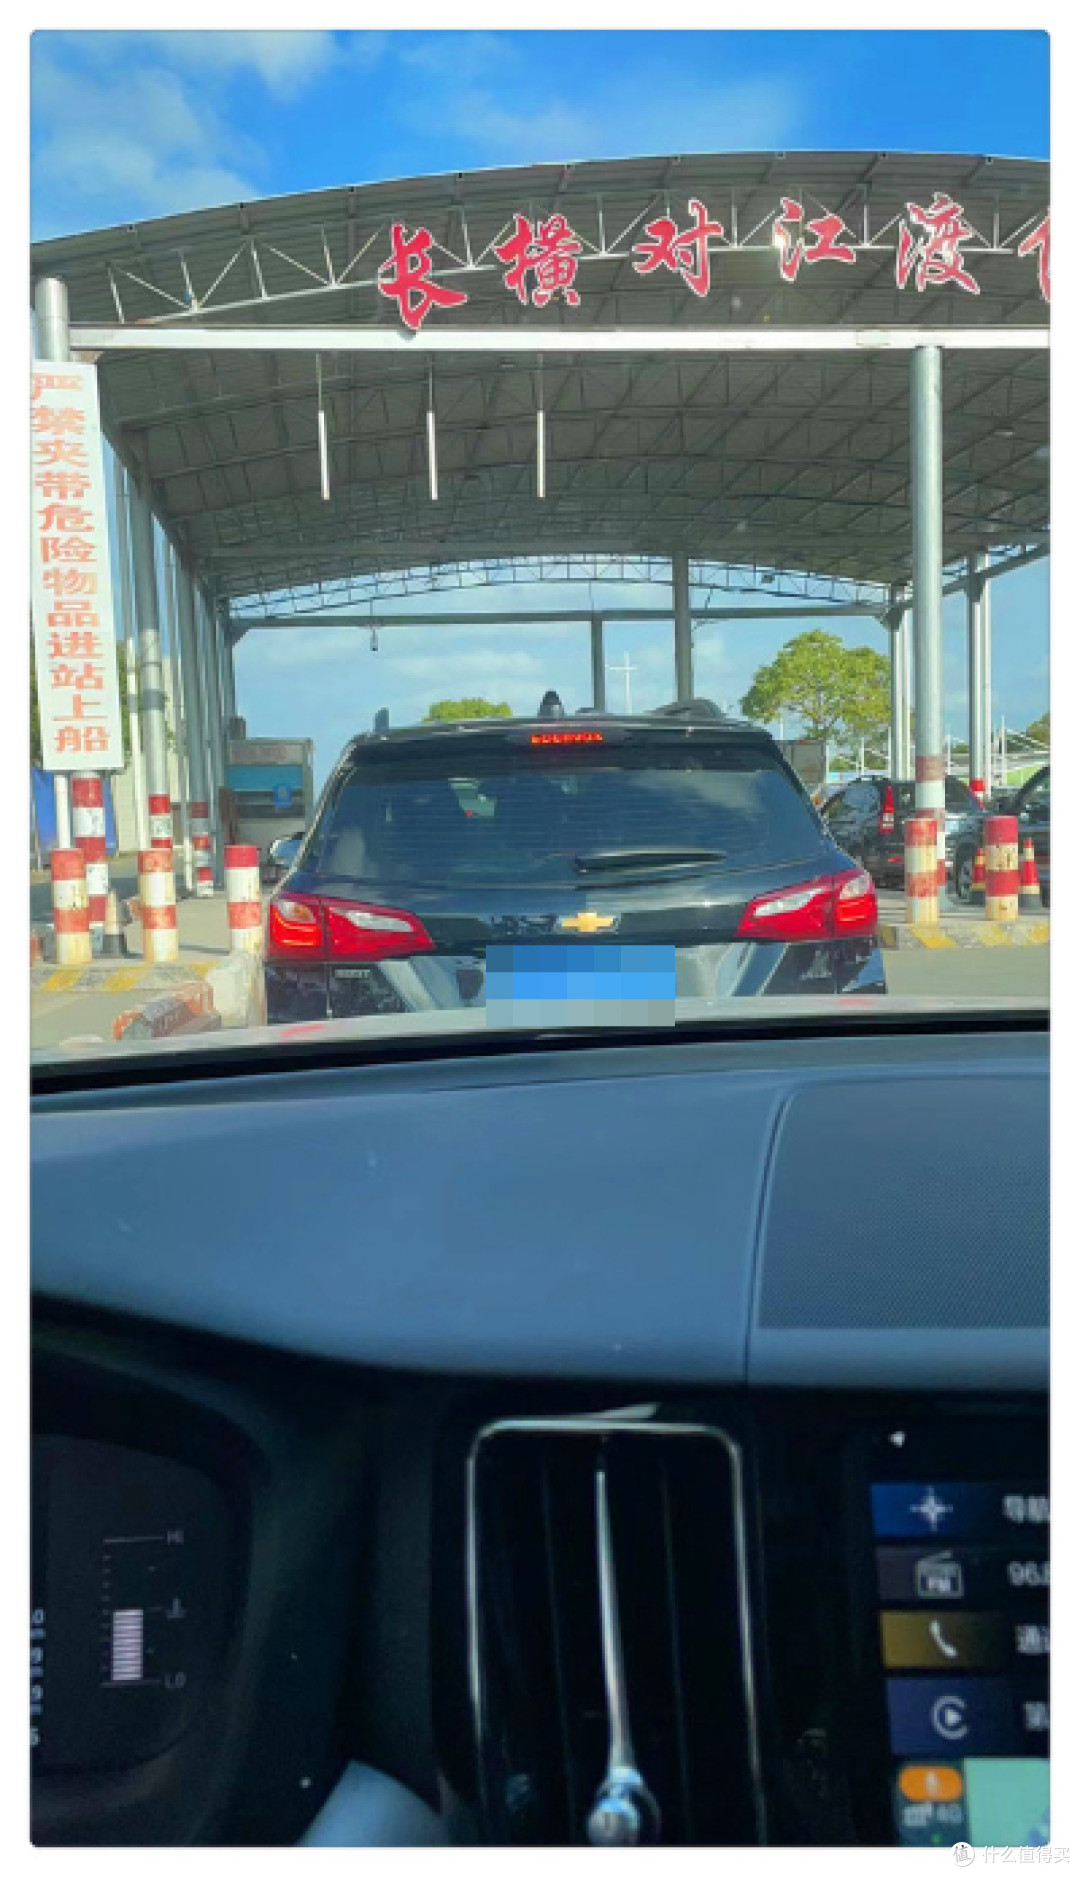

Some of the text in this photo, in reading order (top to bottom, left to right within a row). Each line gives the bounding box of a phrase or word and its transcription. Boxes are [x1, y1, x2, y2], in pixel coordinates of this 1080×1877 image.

[31, 372, 109, 752] 严禁夹带危险物品进站上船
